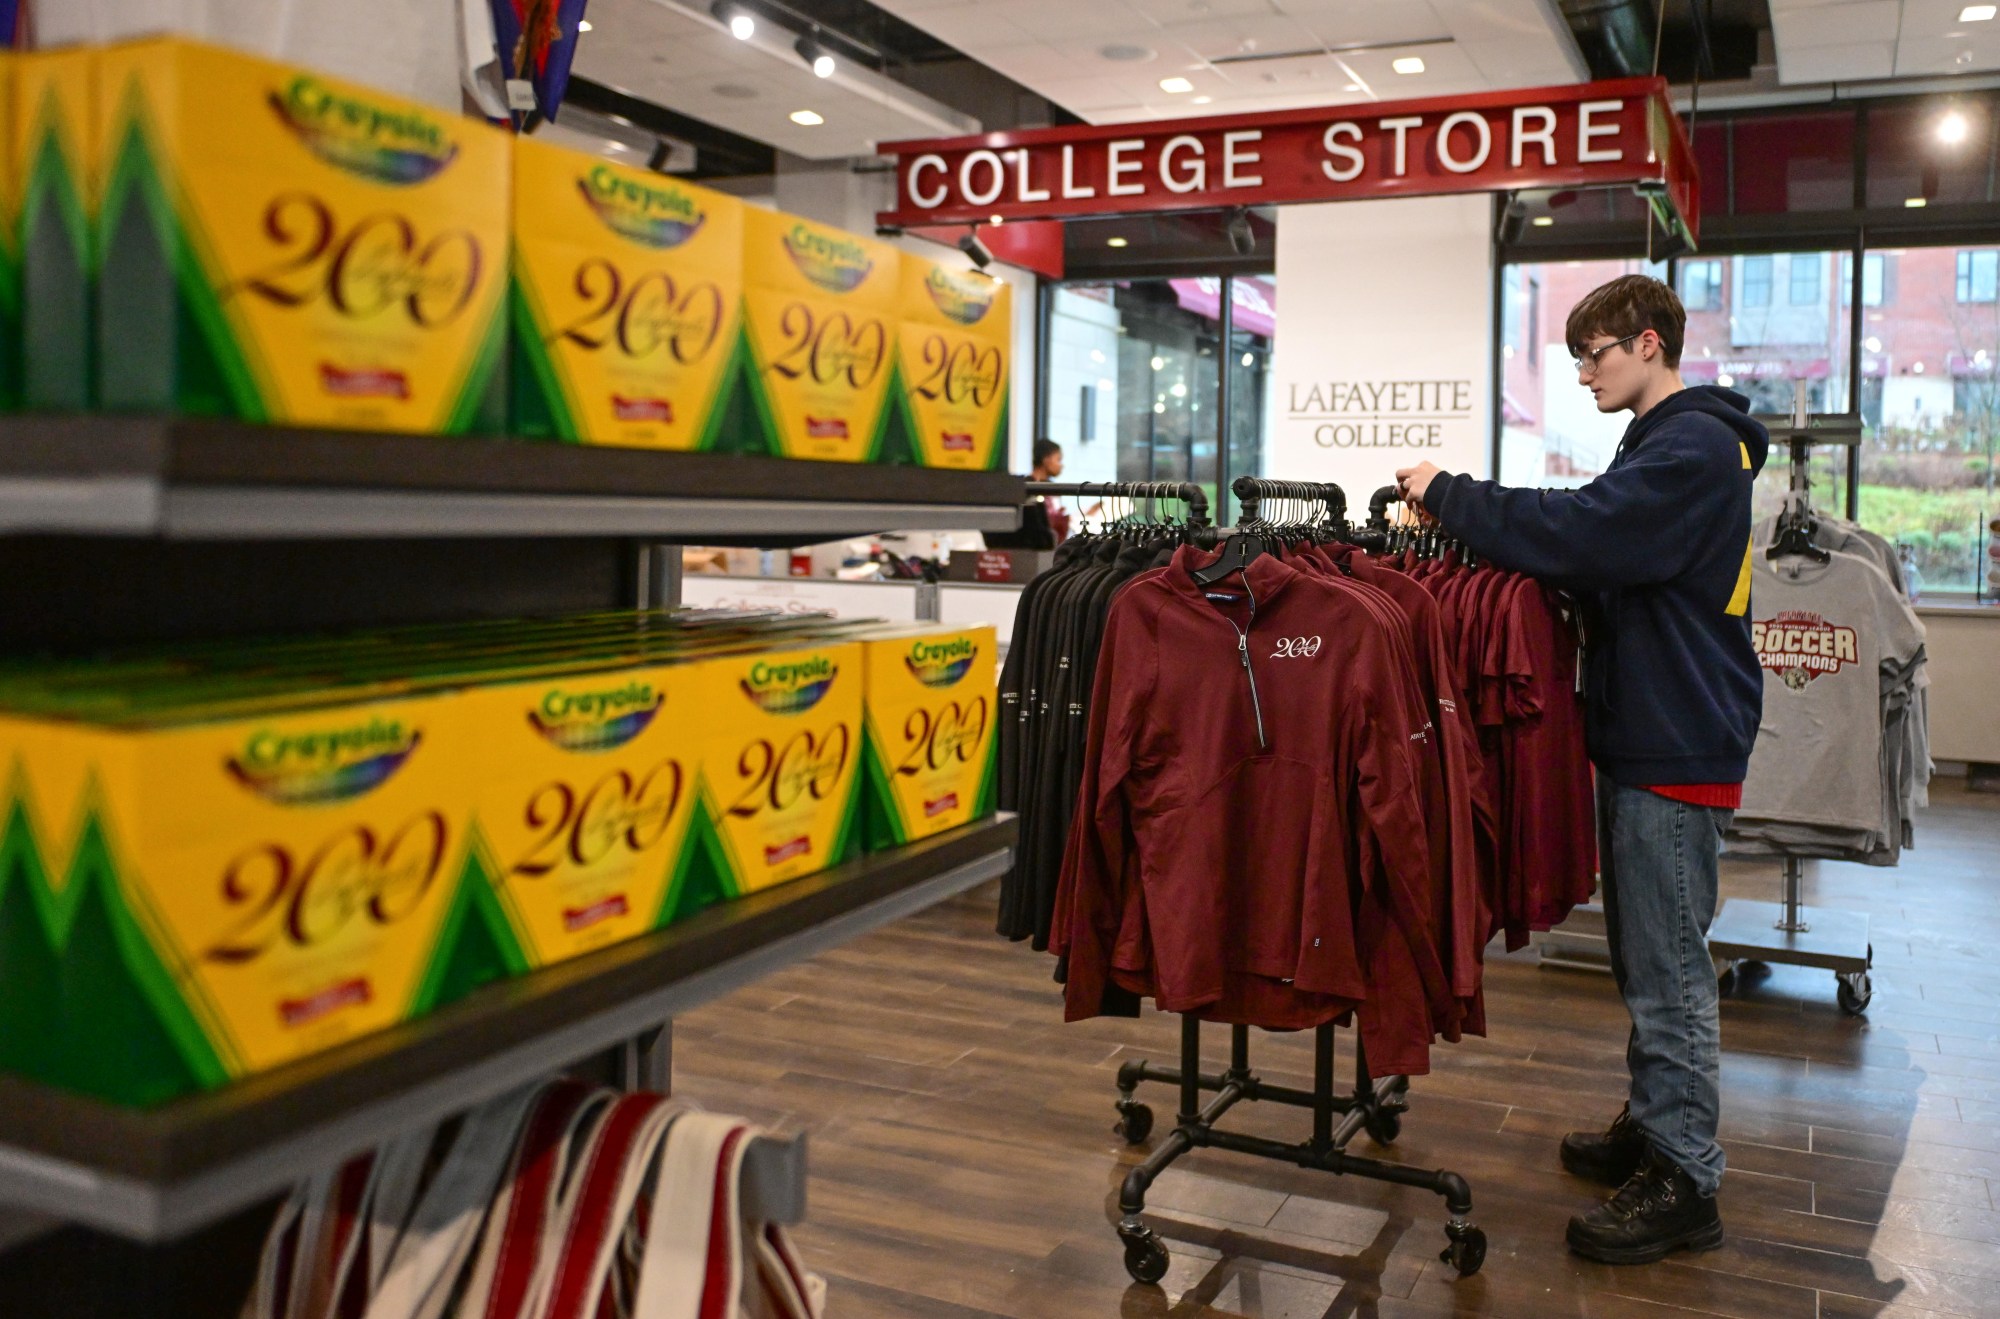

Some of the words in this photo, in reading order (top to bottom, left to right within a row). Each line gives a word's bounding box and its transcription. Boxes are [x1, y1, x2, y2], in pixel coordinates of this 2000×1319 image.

[590, 165, 693, 214] Crayola
[907, 130, 1263, 209] COLLEGE
[1321, 100, 1623, 182] STORE
[220, 190, 484, 330] 200
[548, 255, 724, 366] 200
[762, 301, 886, 390] 200
[910, 334, 1002, 408] 200
[1289, 380, 1472, 413] LAFAYETTE
[1315, 423, 1443, 448] COLLEGE
[750, 656, 830, 687] Crayola
[912, 637, 971, 663] Crayola
[1269, 635, 1322, 659] 200
[1752, 623, 1855, 661] SOCCER
[542, 681, 652, 718] Crayola
[717, 721, 849, 827] 200
[890, 695, 987, 781] 200
[503, 758, 684, 880] 200
[198, 808, 448, 966] 200
